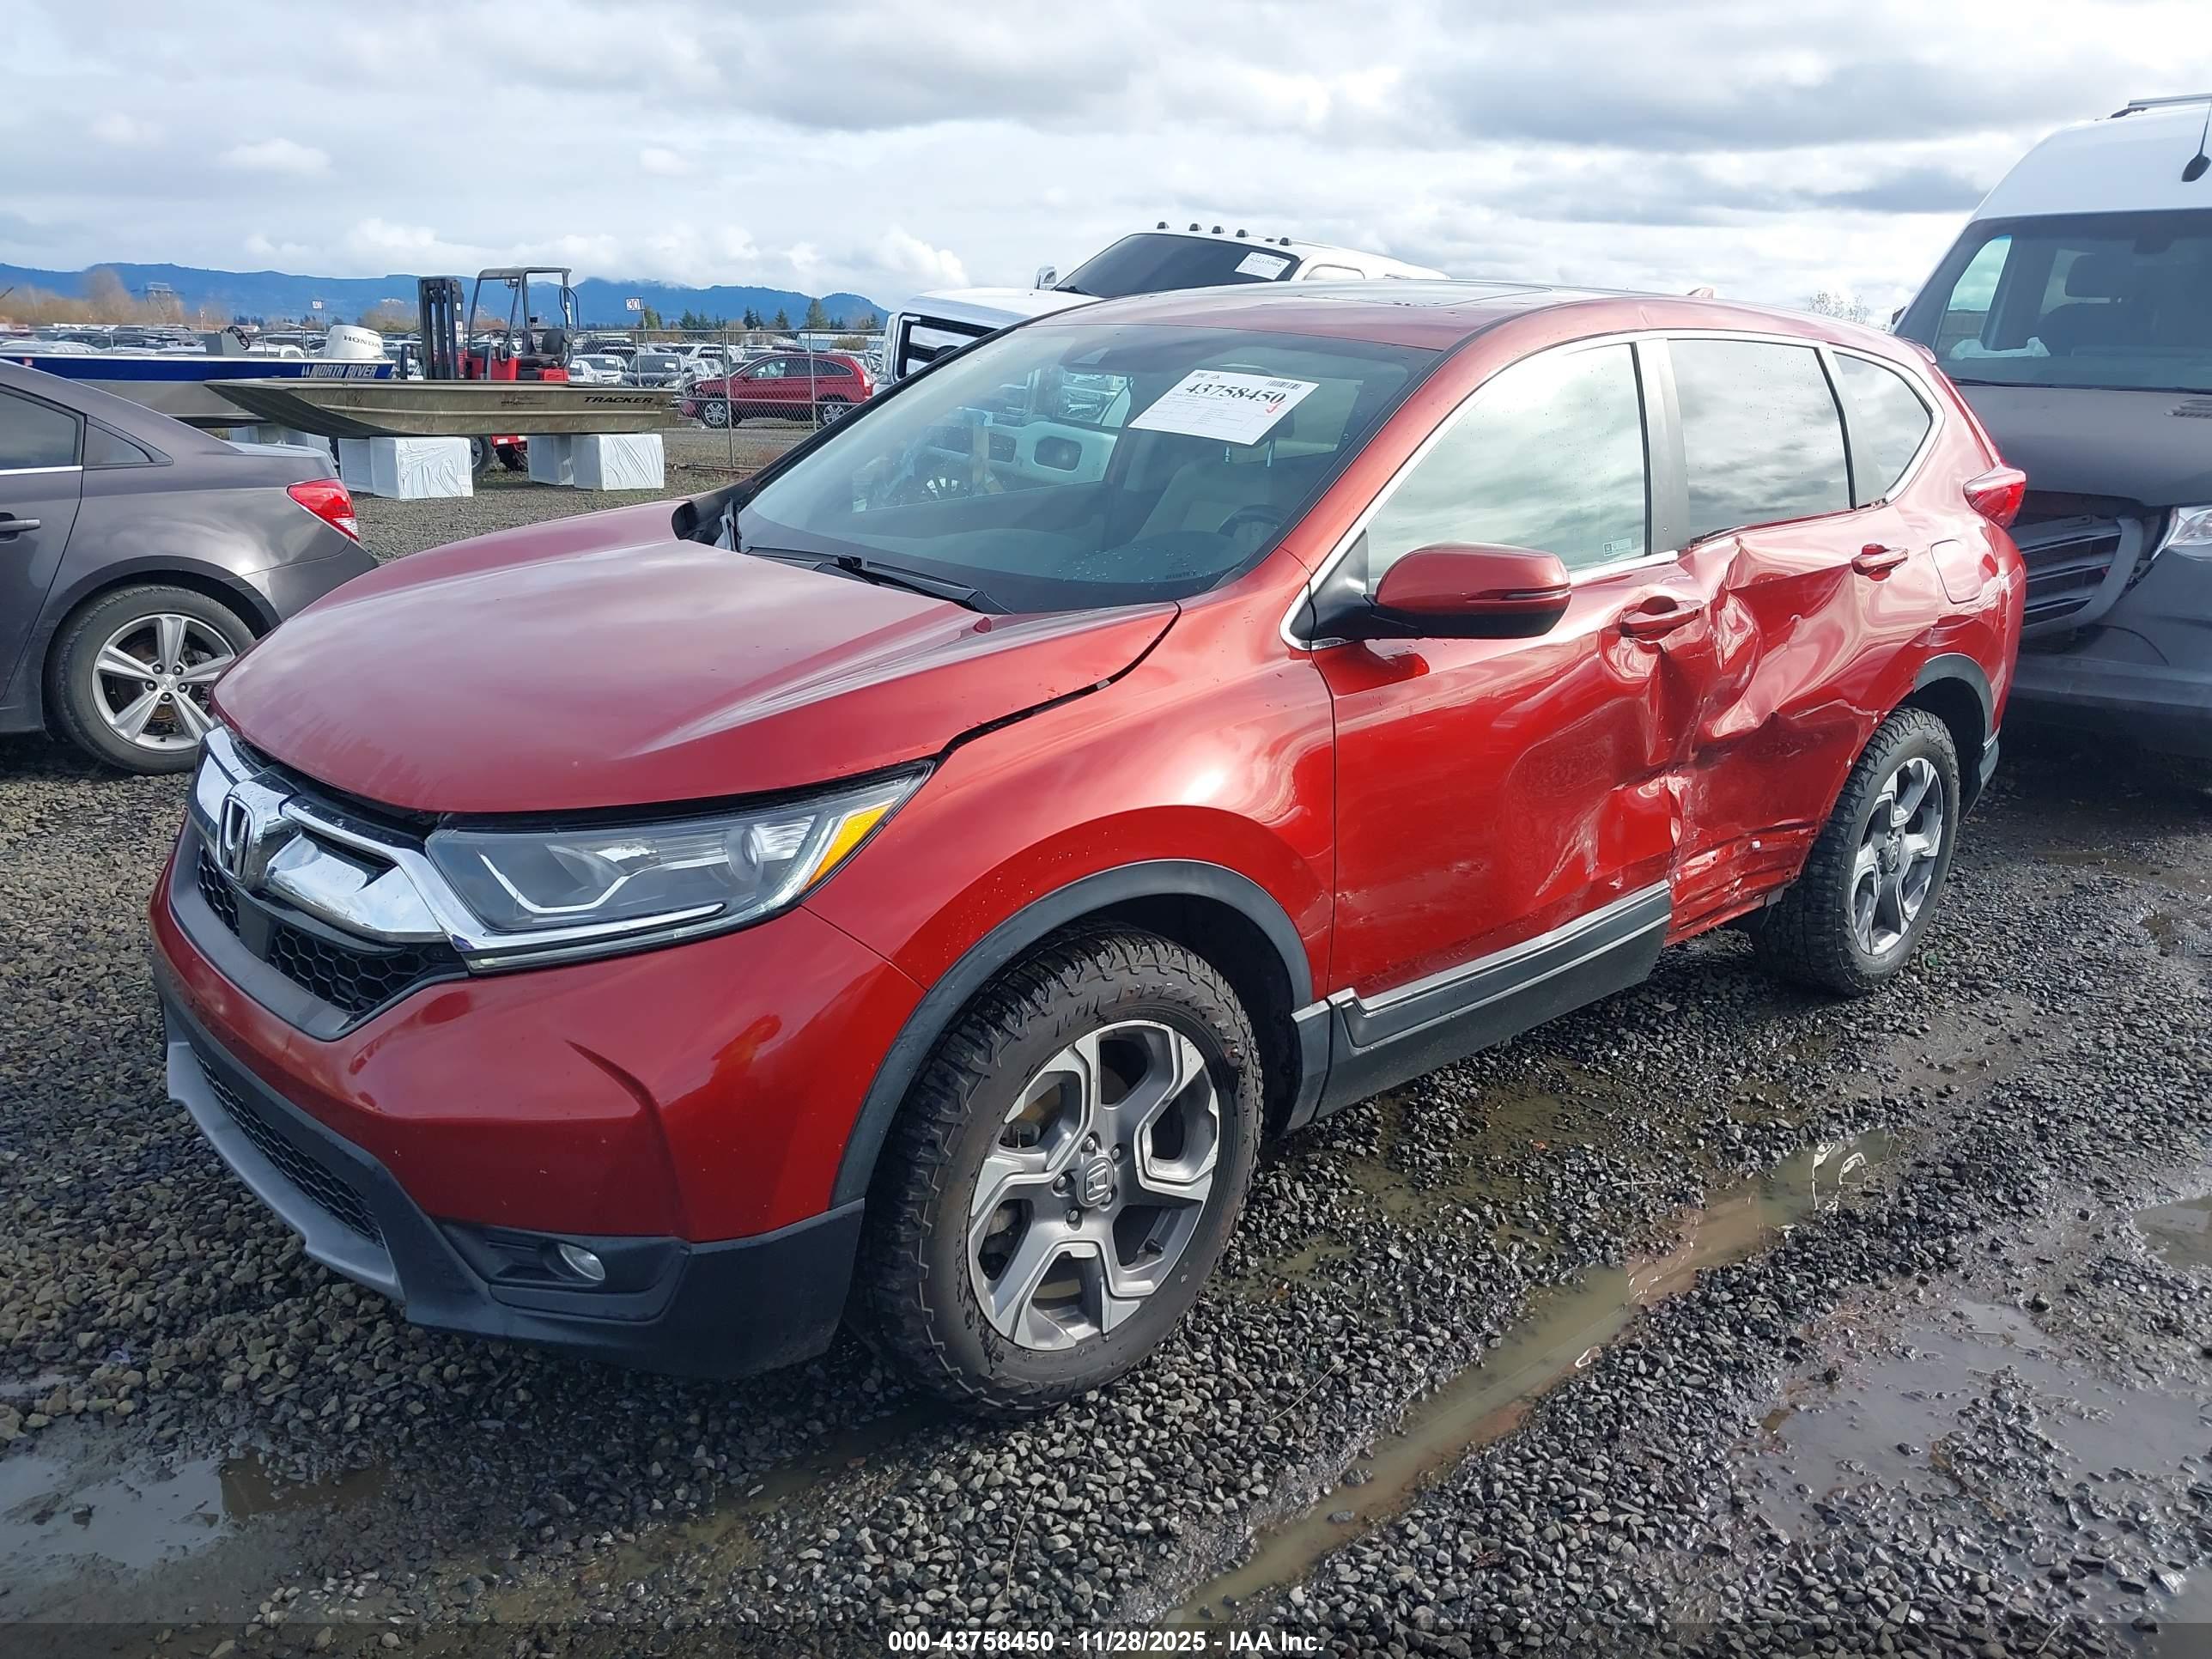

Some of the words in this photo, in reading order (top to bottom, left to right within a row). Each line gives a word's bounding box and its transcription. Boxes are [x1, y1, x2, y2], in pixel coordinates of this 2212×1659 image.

[628, 299, 638, 310] 30
[343, 335, 380, 349] HONDA
[310, 363, 345, 379] NORTH
[345, 363, 379, 379] RIVER
[583, 396, 654, 404] TRACKER
[1185, 382, 1287, 404] 43758450
